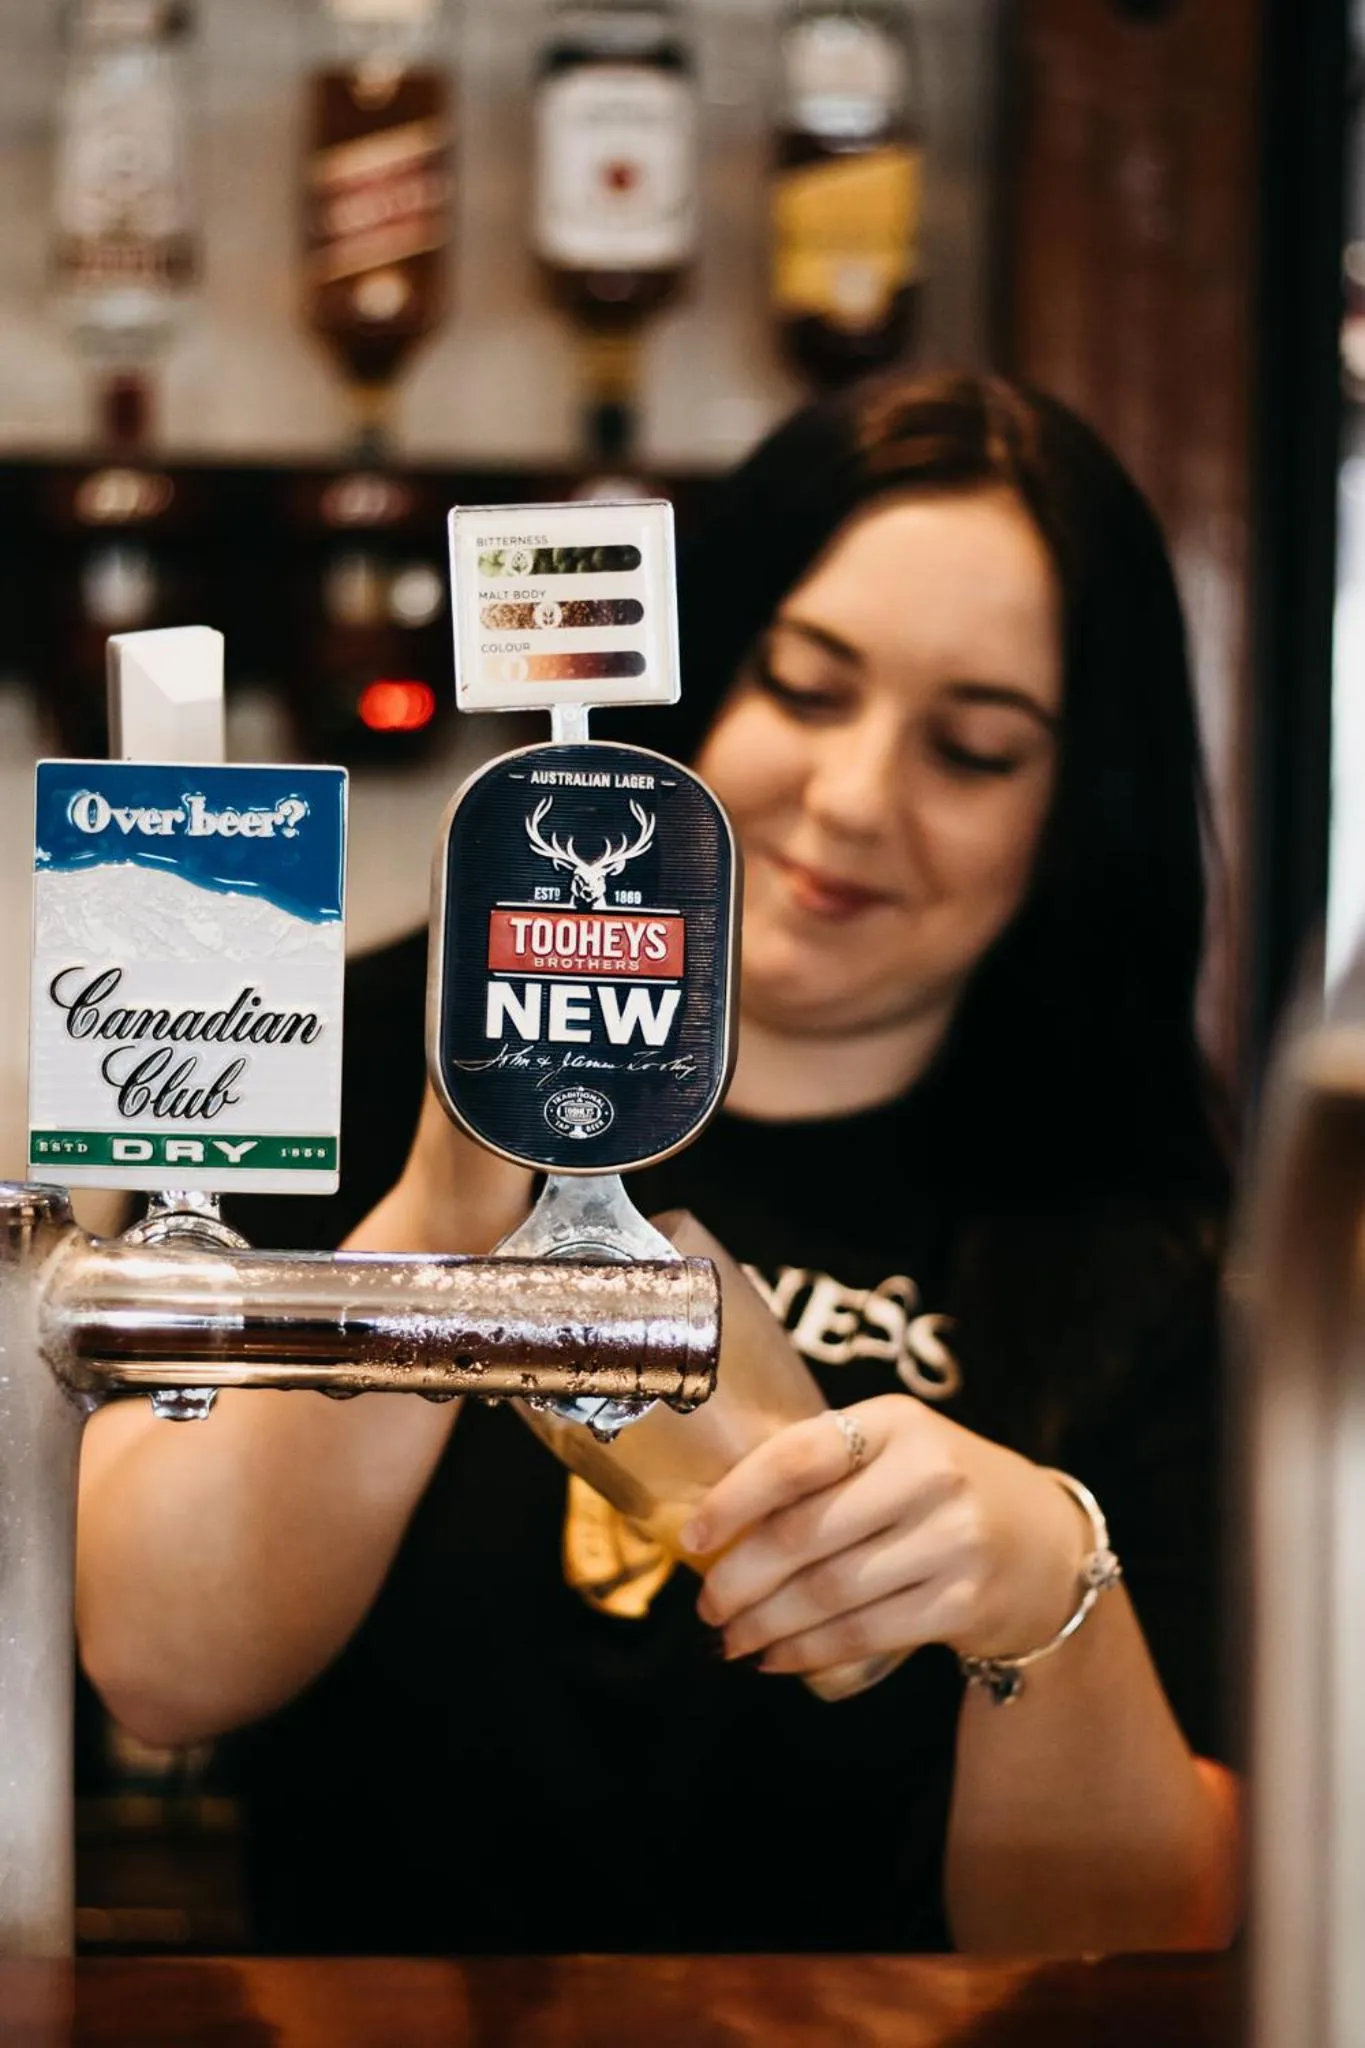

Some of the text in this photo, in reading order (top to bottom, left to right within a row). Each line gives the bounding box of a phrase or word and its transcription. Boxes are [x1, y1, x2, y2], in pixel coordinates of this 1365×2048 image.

[476, 535, 548, 547] BITTERNESS
[478, 589, 547, 600] MALT BODY
[481, 642, 531, 653] COLOUR
[530, 771, 655, 790] AUSTRALIAN LAGER
[71, 790, 306, 838] Over beer?
[509, 916, 668, 960] TOOHEYS
[534, 957, 640, 972] BROTHERS
[50, 966, 322, 1044] Canadian
[485, 981, 682, 1046] NEW
[101, 1045, 246, 1119] Club
[39, 1141, 88, 1153] ESTD
[112, 1138, 258, 1163] DRY
